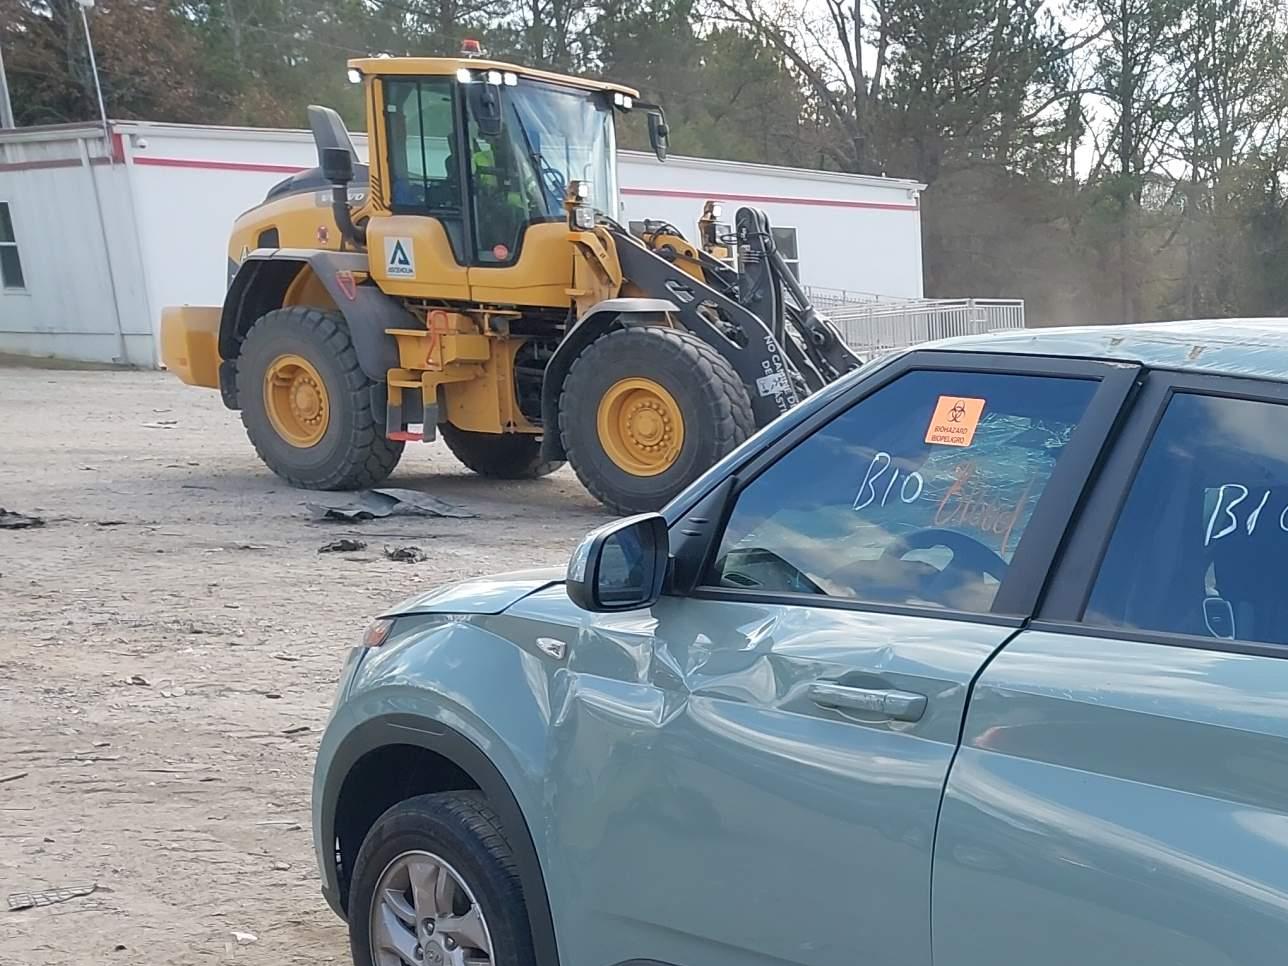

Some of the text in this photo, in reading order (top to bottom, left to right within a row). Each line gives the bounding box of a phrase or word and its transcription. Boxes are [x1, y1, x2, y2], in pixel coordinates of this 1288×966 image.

[764, 335, 776, 352] NO
[934, 425, 968, 435] BIOHAZARD
[931, 435, 965, 444] BIOPELIGRO
[853, 452, 924, 512] BIO
